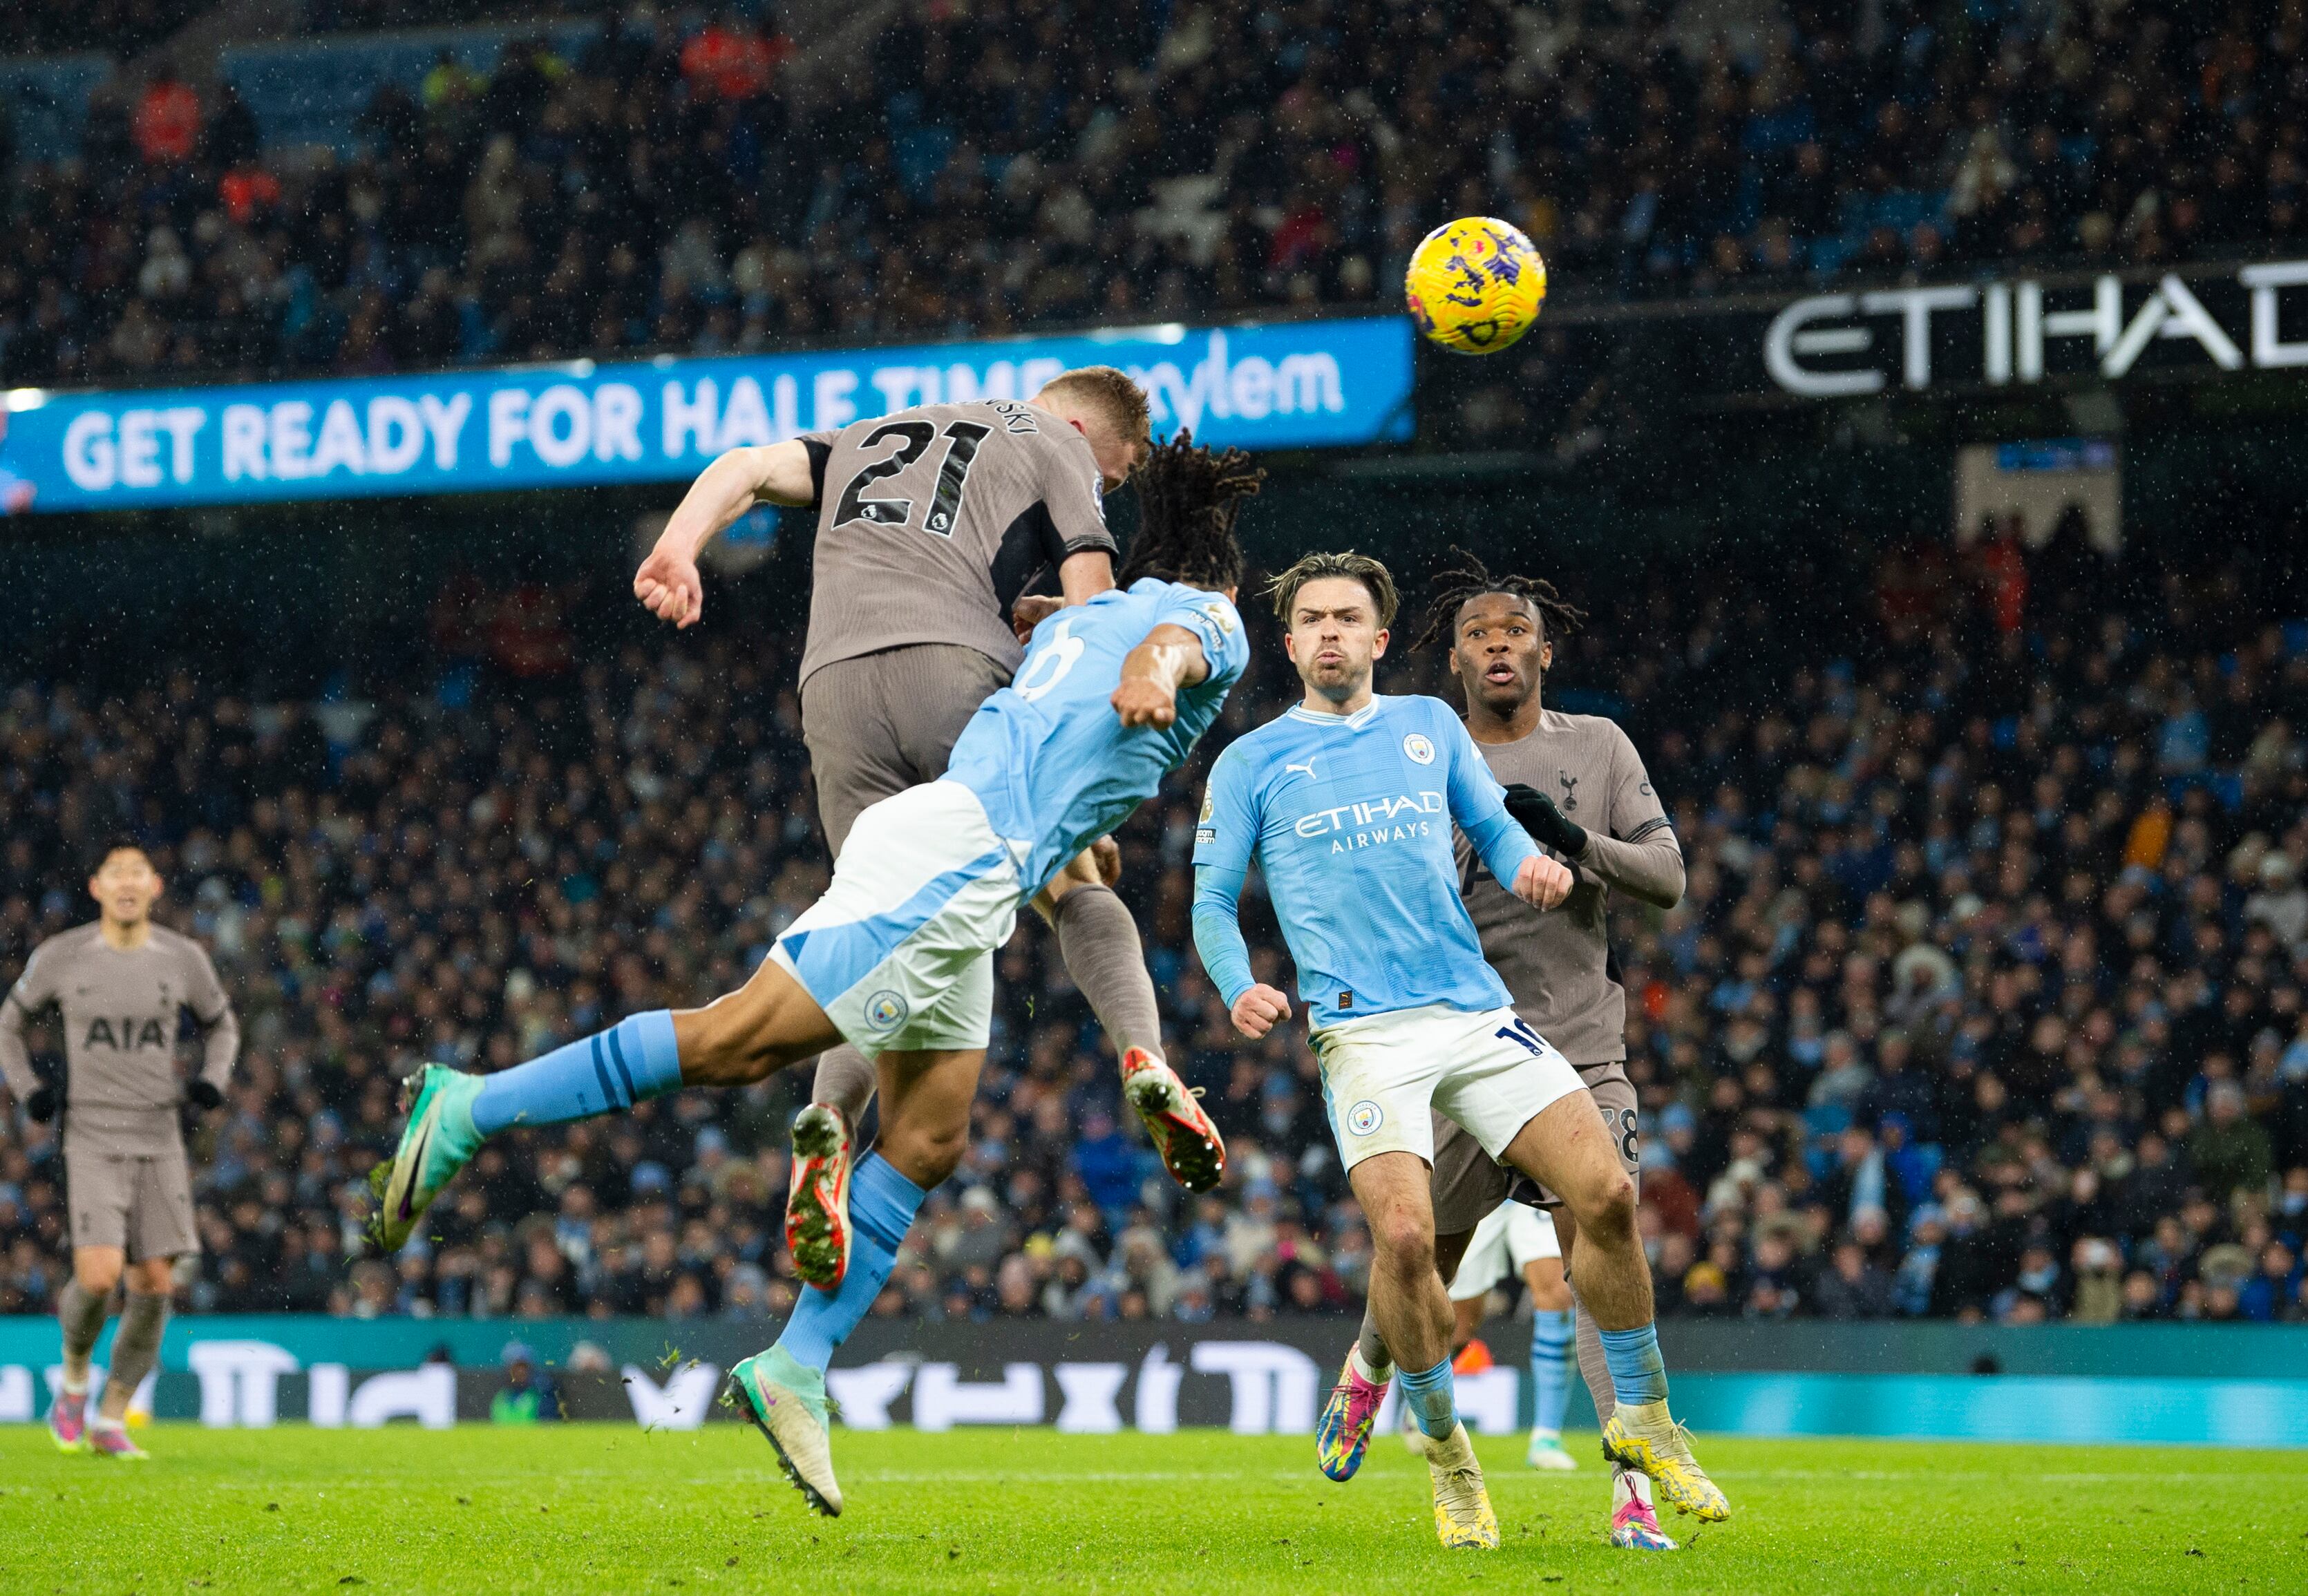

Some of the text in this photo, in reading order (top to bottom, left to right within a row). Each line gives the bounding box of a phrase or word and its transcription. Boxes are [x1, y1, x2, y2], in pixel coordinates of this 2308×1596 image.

[63, 406, 206, 491] GET
[223, 391, 472, 482] READY
[489, 382, 644, 469] FOR
[831, 419, 994, 539] 21
[1012, 616, 1085, 703] 6
[1295, 791, 1443, 837] ETIHAD
[1332, 821, 1429, 854] AIRWAYS
[83, 1017, 164, 1051] AIA
